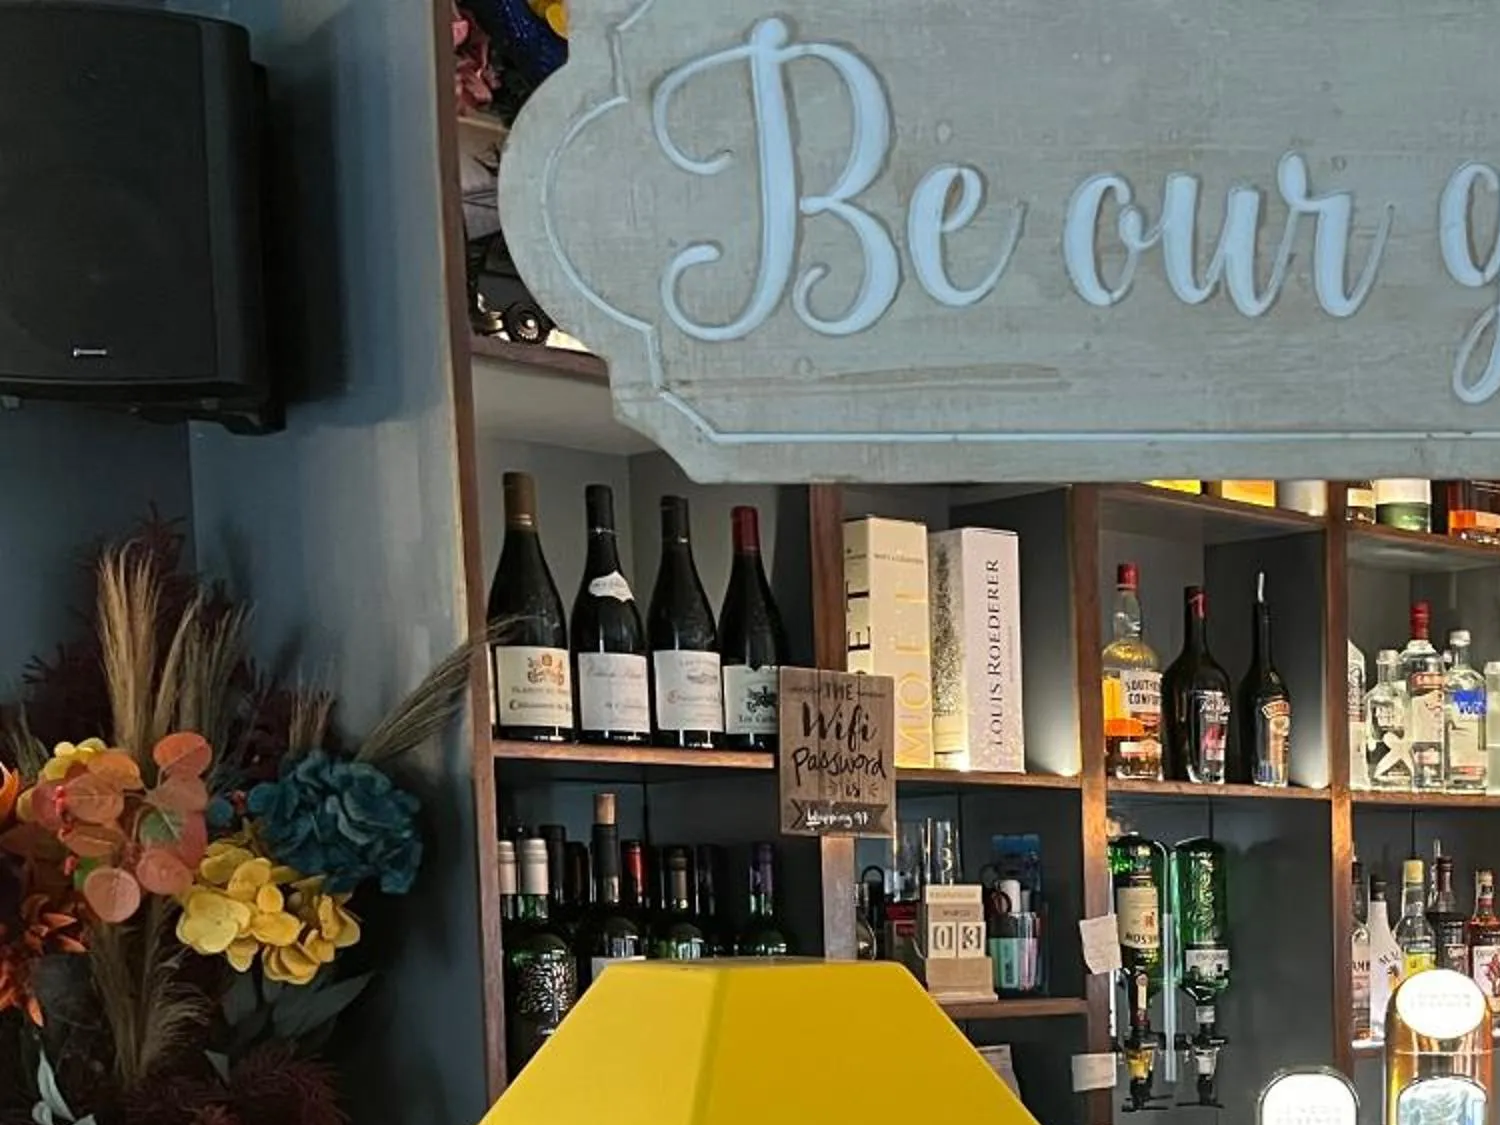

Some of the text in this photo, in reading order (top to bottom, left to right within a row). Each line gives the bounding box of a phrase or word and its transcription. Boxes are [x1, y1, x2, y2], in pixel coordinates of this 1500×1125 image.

[651, 15, 1024, 341] Be
[1063, 153, 1392, 319] our
[824, 682, 853, 700] THE
[986, 559, 1004, 747] LOUIS ROEDERER
